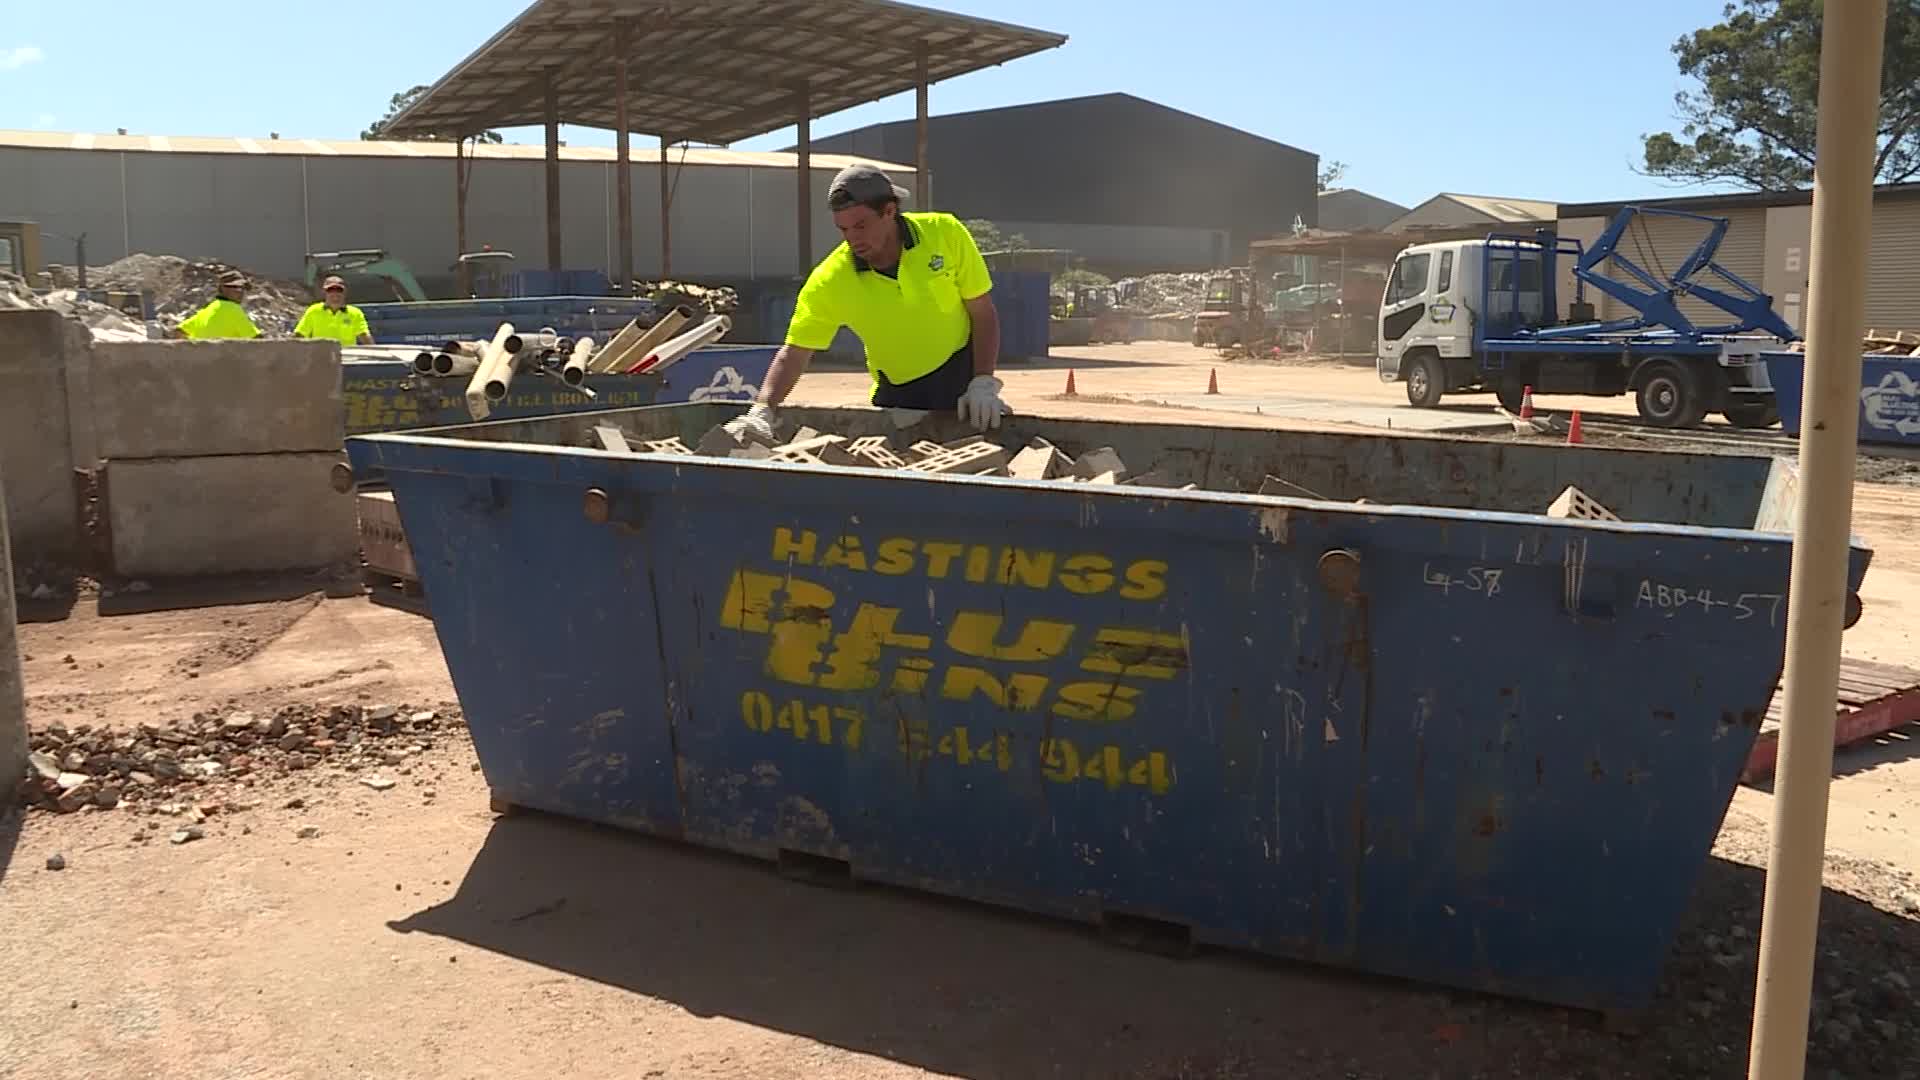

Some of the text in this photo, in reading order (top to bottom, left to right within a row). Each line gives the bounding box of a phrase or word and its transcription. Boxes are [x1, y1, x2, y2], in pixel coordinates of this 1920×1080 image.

[772, 526, 1169, 600] HASTINGS
[1636, 579, 1783, 628] ABB-4-57
[719, 567, 1190, 680] BLUE
[740, 690, 866, 750] 0417
[1040, 736, 1173, 795] 944
